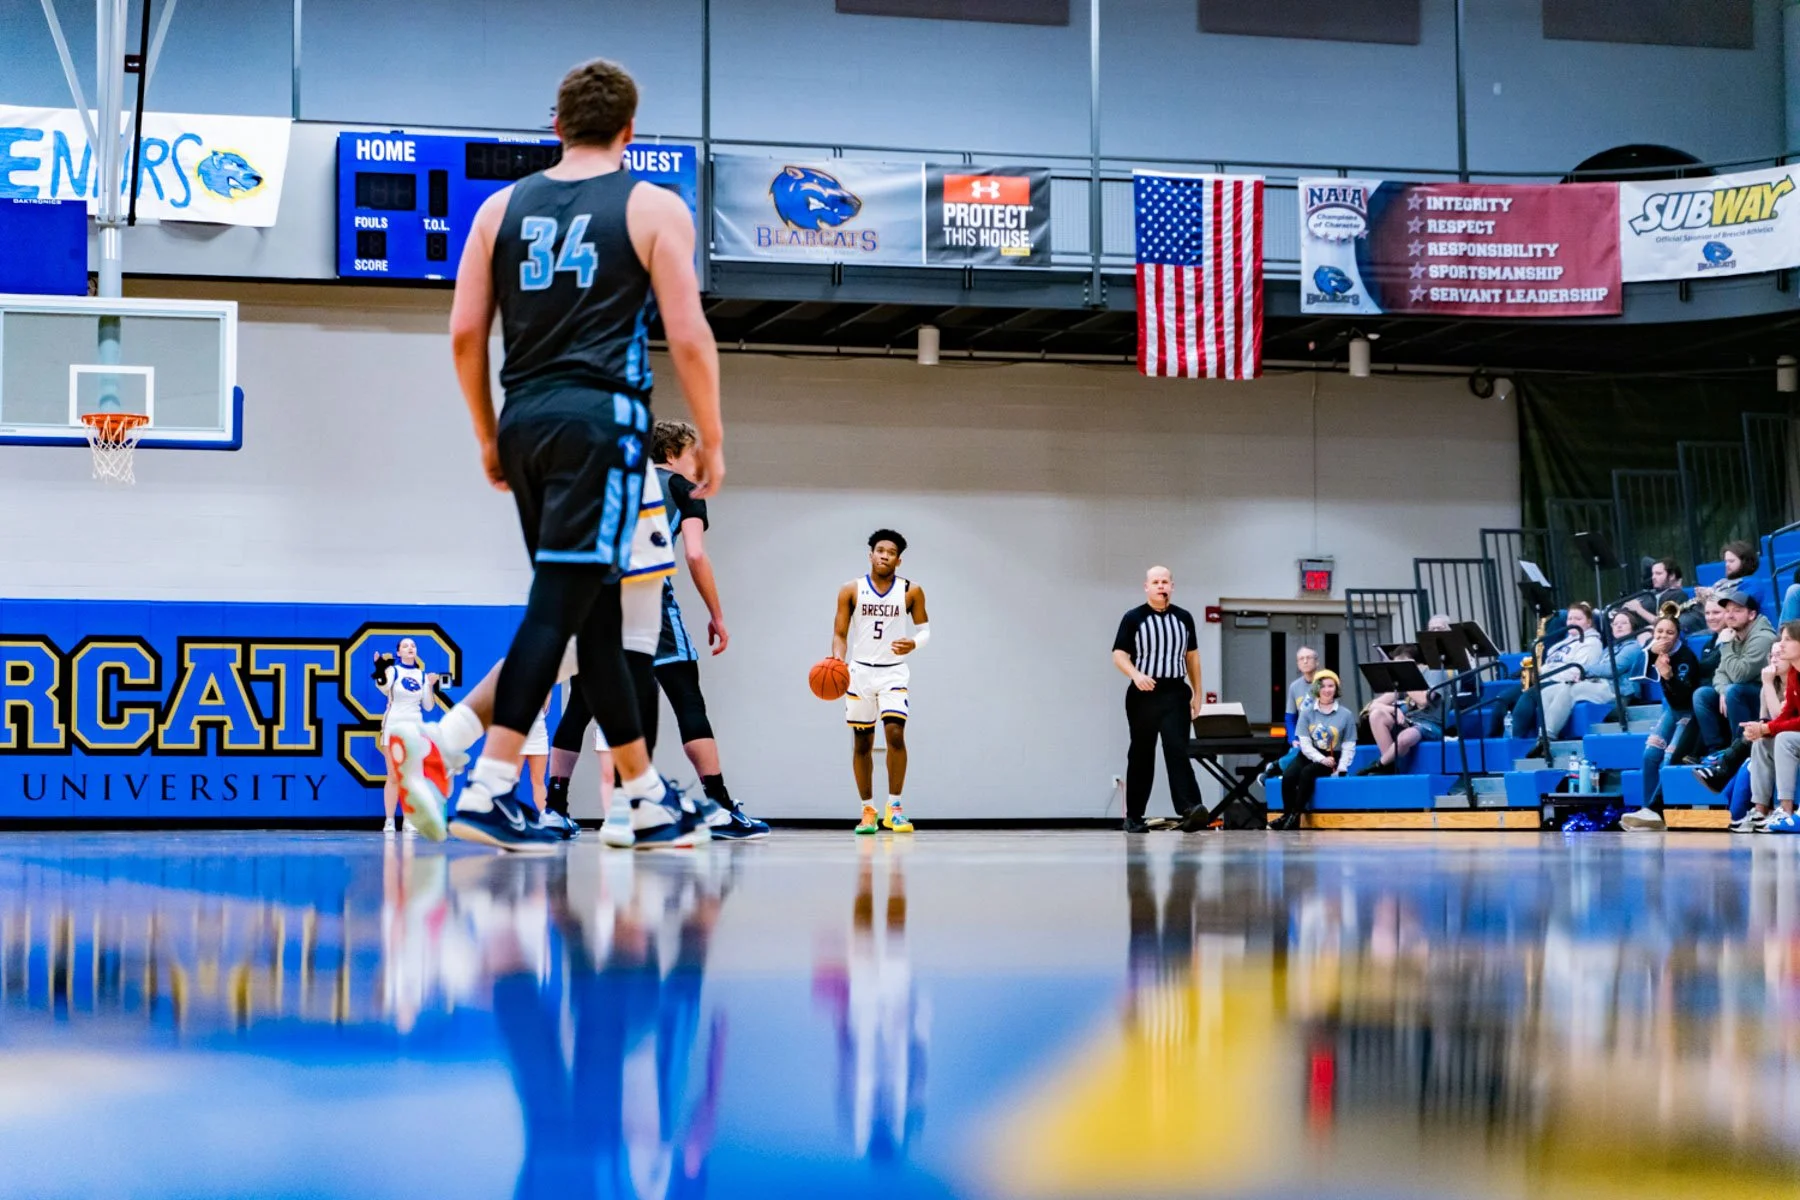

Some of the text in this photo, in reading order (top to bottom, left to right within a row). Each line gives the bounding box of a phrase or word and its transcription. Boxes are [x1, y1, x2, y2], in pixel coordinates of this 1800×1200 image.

[356, 139, 416, 162] HOME
[622, 150, 683, 172] GUEST
[1308, 187, 1365, 210] NAIA
[1426, 196, 1513, 212] INTEGRITY
[1629, 174, 1796, 236] SUBWAY
[354, 216, 388, 229] FOULS
[423, 218, 450, 231] T.O.L.
[943, 203, 1029, 229] PROTECT
[1427, 219, 1496, 235] RESPECT
[755, 225, 878, 252] BEARCATS
[943, 227, 1034, 248] THIS HOUSE.
[519, 213, 599, 291] 34
[1427, 242, 1559, 258] RESPONSIBILITY
[354, 259, 388, 271] SCORE
[1428, 264, 1564, 281] SPORTSMANSHIP
[1429, 287, 1609, 304] SERVANT LEADERSHIP
[862, 604, 900, 617] BRESCIA
[873, 621, 884, 640] 5
[23, 774, 327, 801] UNIVERSITY
